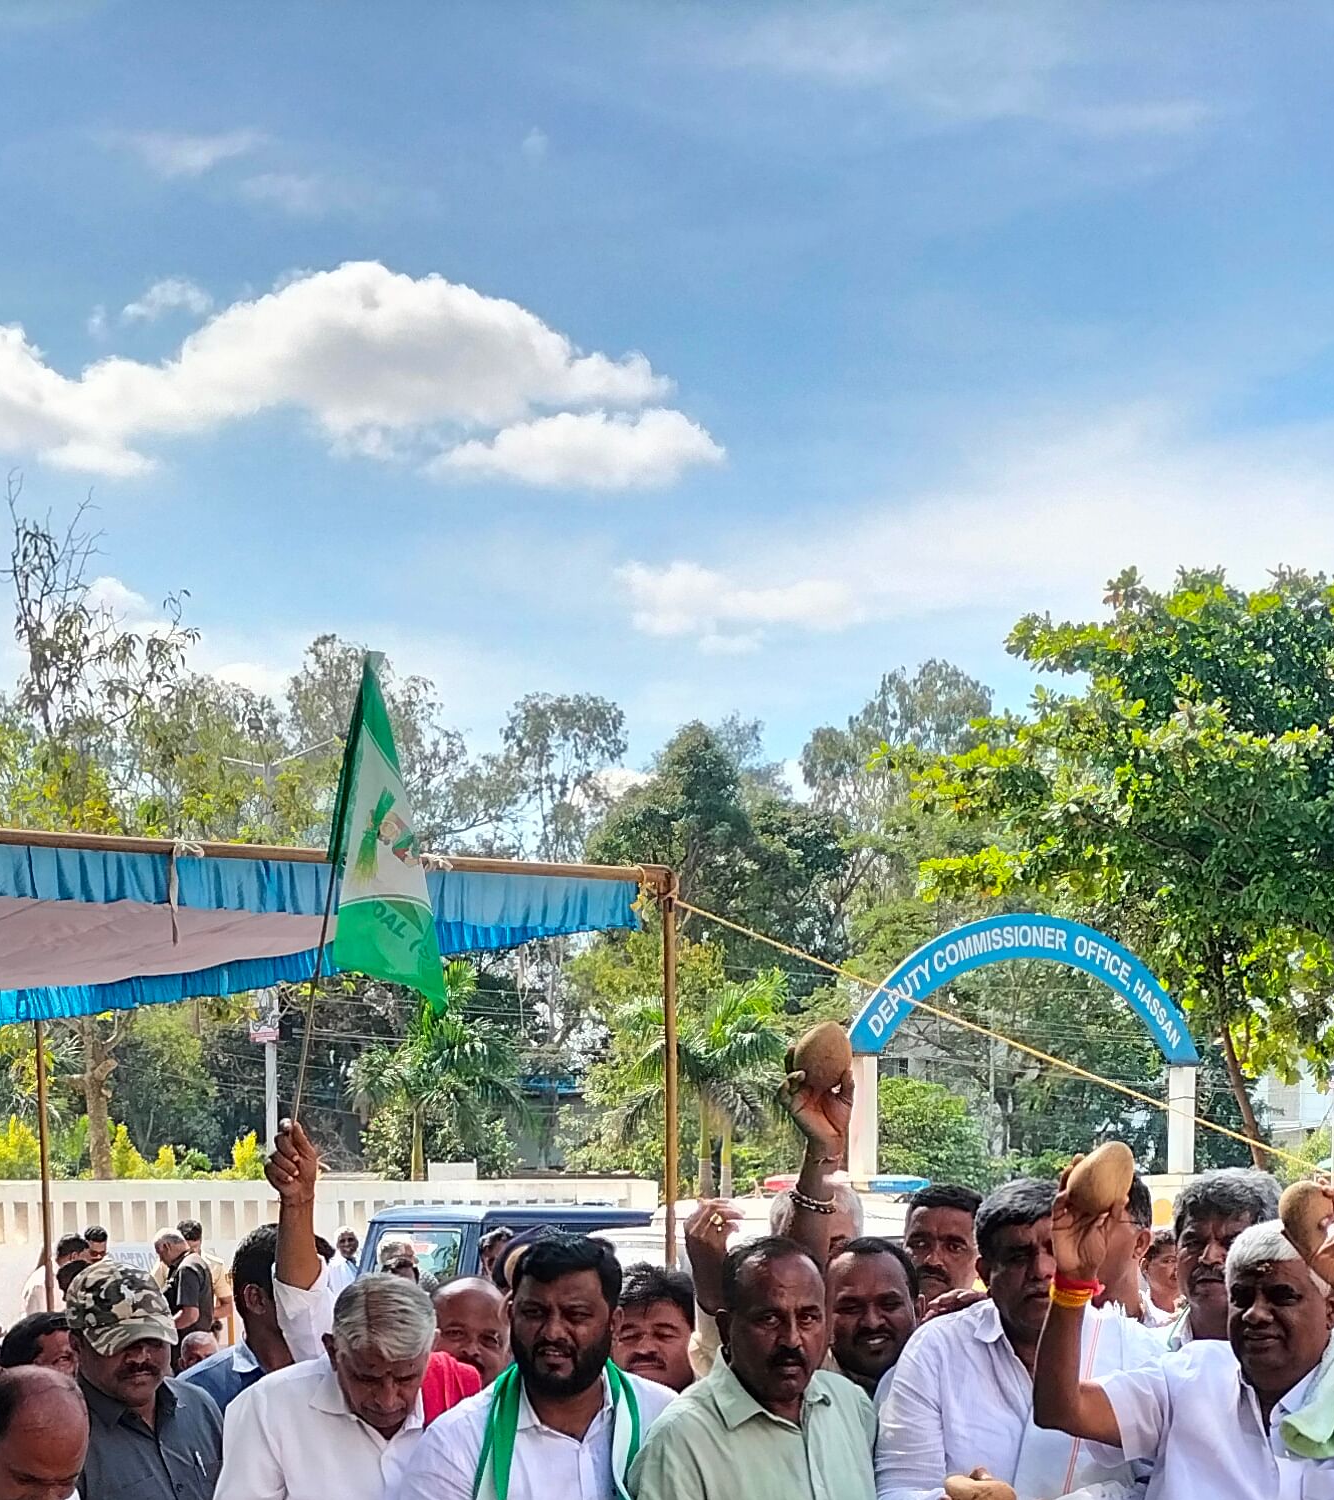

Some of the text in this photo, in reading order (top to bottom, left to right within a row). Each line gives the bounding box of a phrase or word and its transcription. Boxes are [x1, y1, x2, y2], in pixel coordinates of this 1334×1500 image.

[867, 926, 1181, 1049] DEPUTY COMMISSIONER OFFICE, HASSAN
